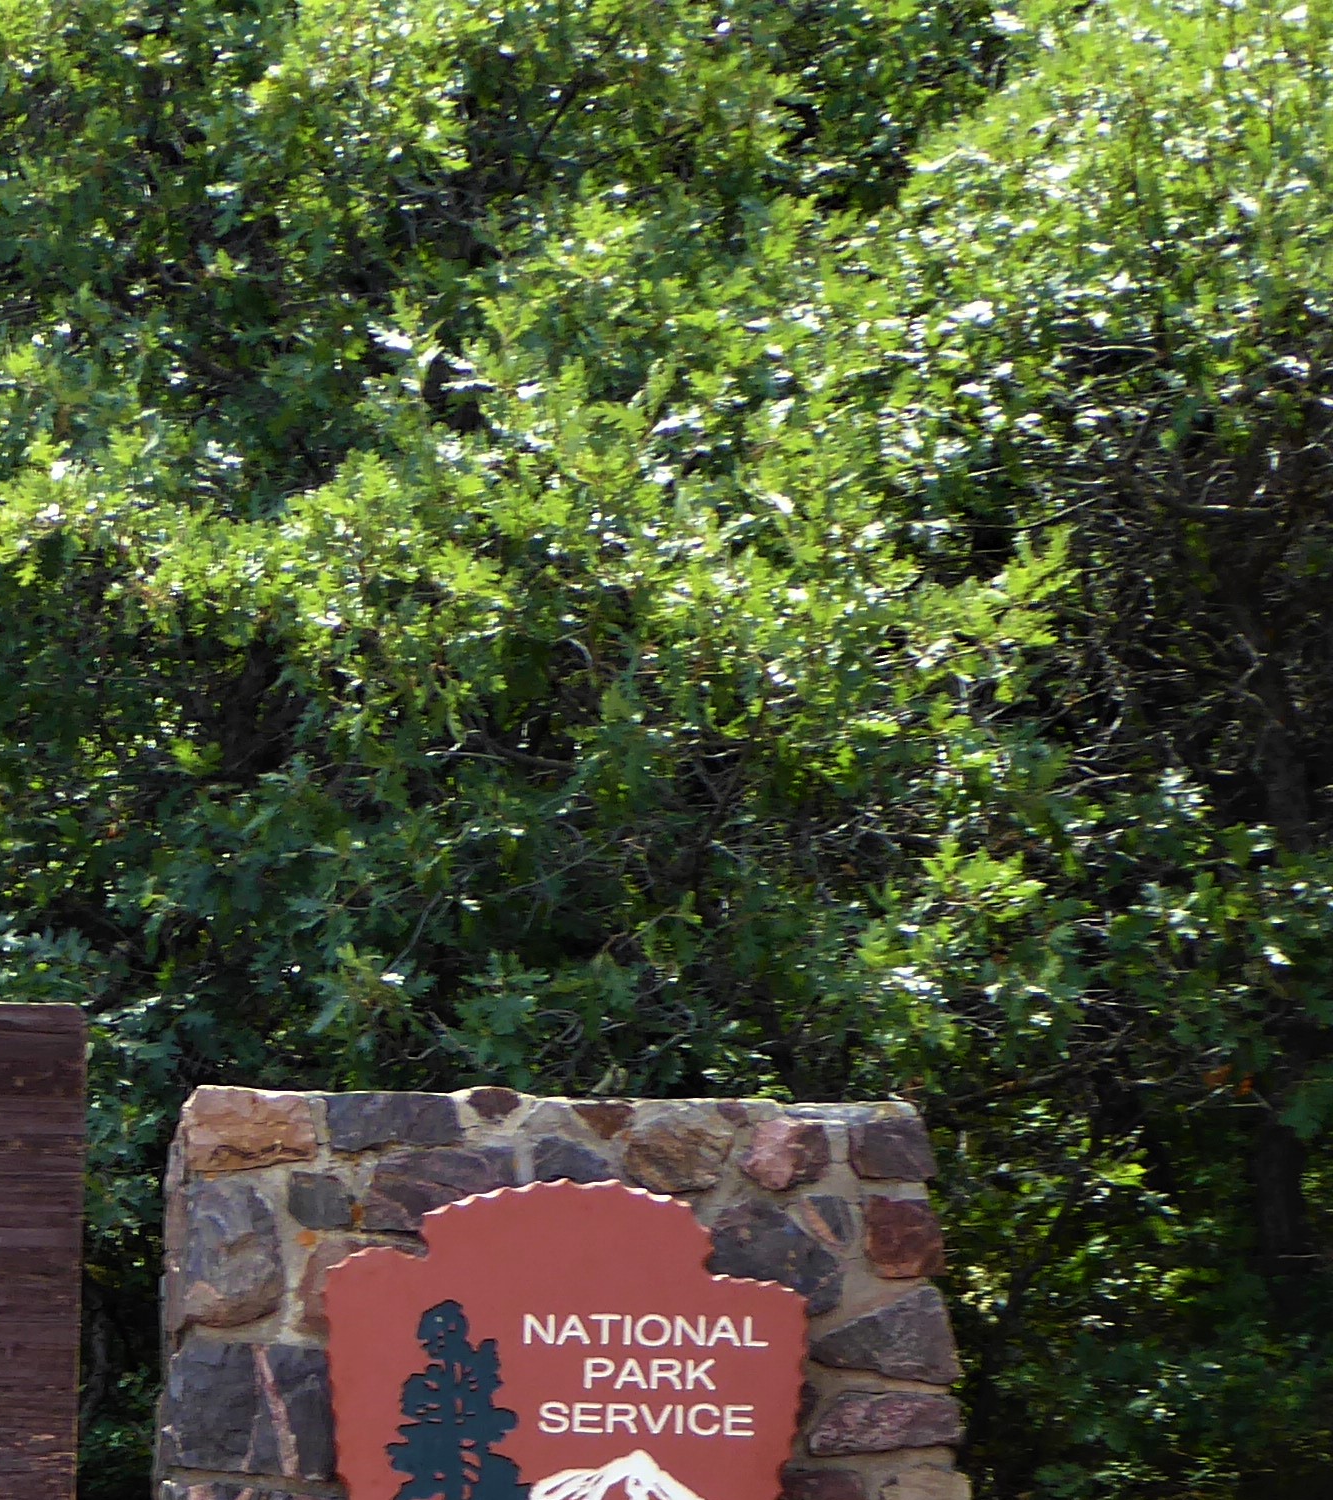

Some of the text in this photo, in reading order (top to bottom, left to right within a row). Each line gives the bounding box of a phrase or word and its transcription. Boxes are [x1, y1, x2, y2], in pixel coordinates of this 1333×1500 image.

[521, 1312, 770, 1348] NATIONAL
[582, 1357, 717, 1391] PARK
[536, 1401, 756, 1437] SERVICE
